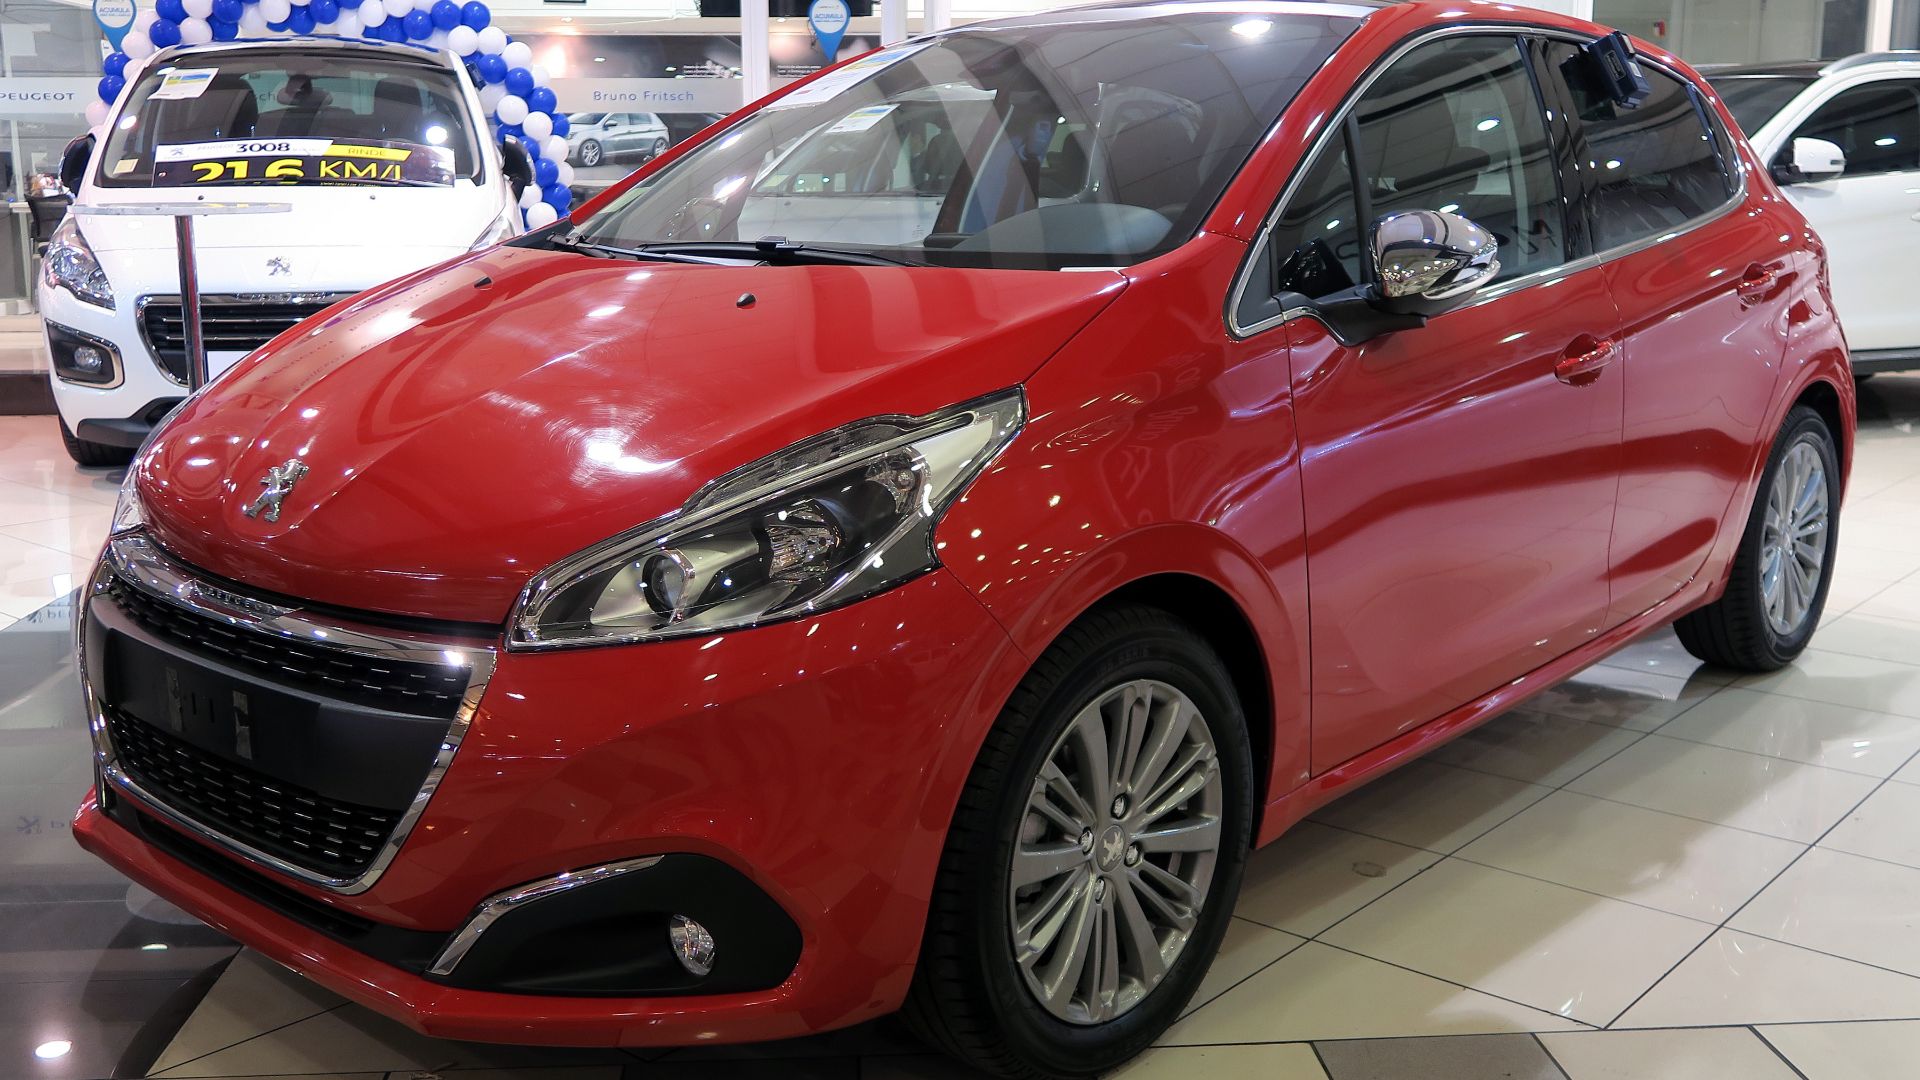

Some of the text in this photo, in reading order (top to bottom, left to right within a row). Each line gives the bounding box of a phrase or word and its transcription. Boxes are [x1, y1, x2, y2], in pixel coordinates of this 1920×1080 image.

[0, 92, 75, 101] PEUGEOT
[593, 90, 694, 101] Bruno Fritsch
[235, 142, 291, 153] 3008
[347, 147, 385, 157] RINDE
